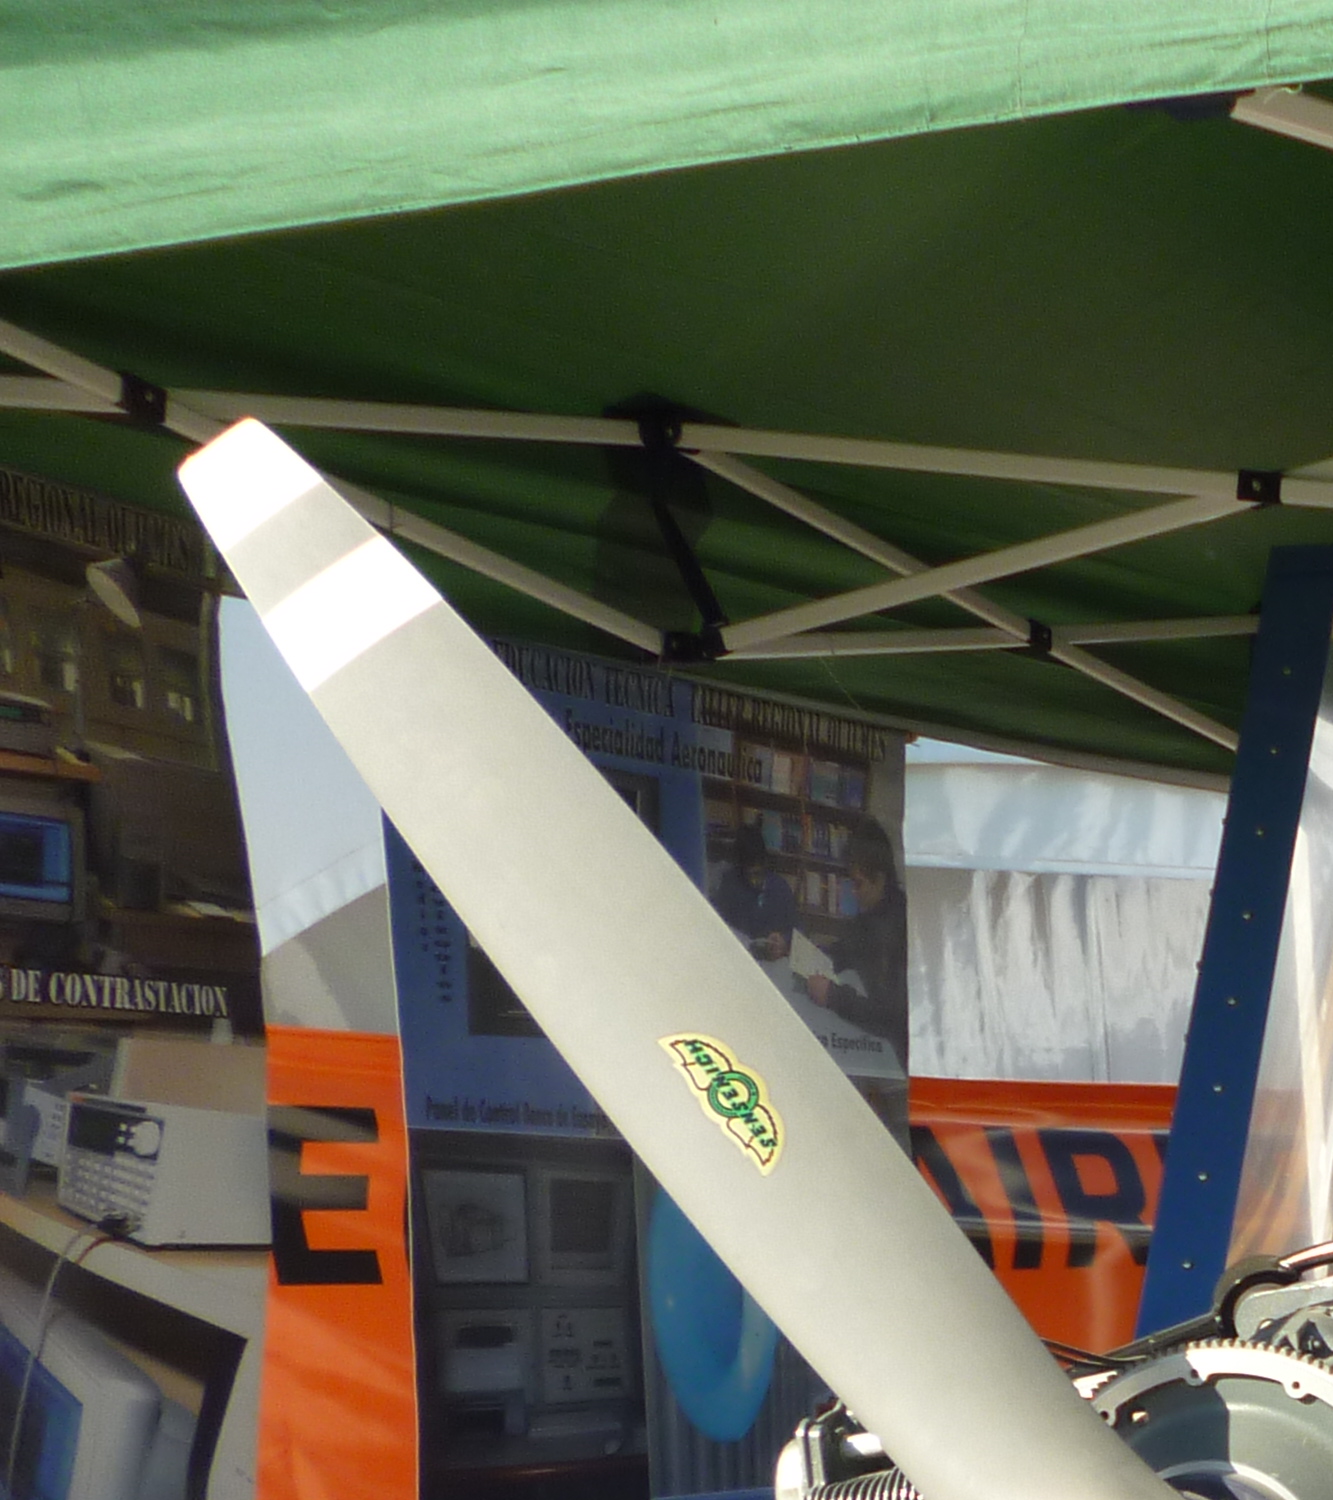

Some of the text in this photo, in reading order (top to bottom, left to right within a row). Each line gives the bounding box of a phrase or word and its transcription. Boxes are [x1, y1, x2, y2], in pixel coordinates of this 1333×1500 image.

[11, 967, 229, 1017] DE CONTRASTACION
[684, 1039, 778, 1149] SENSENICH
